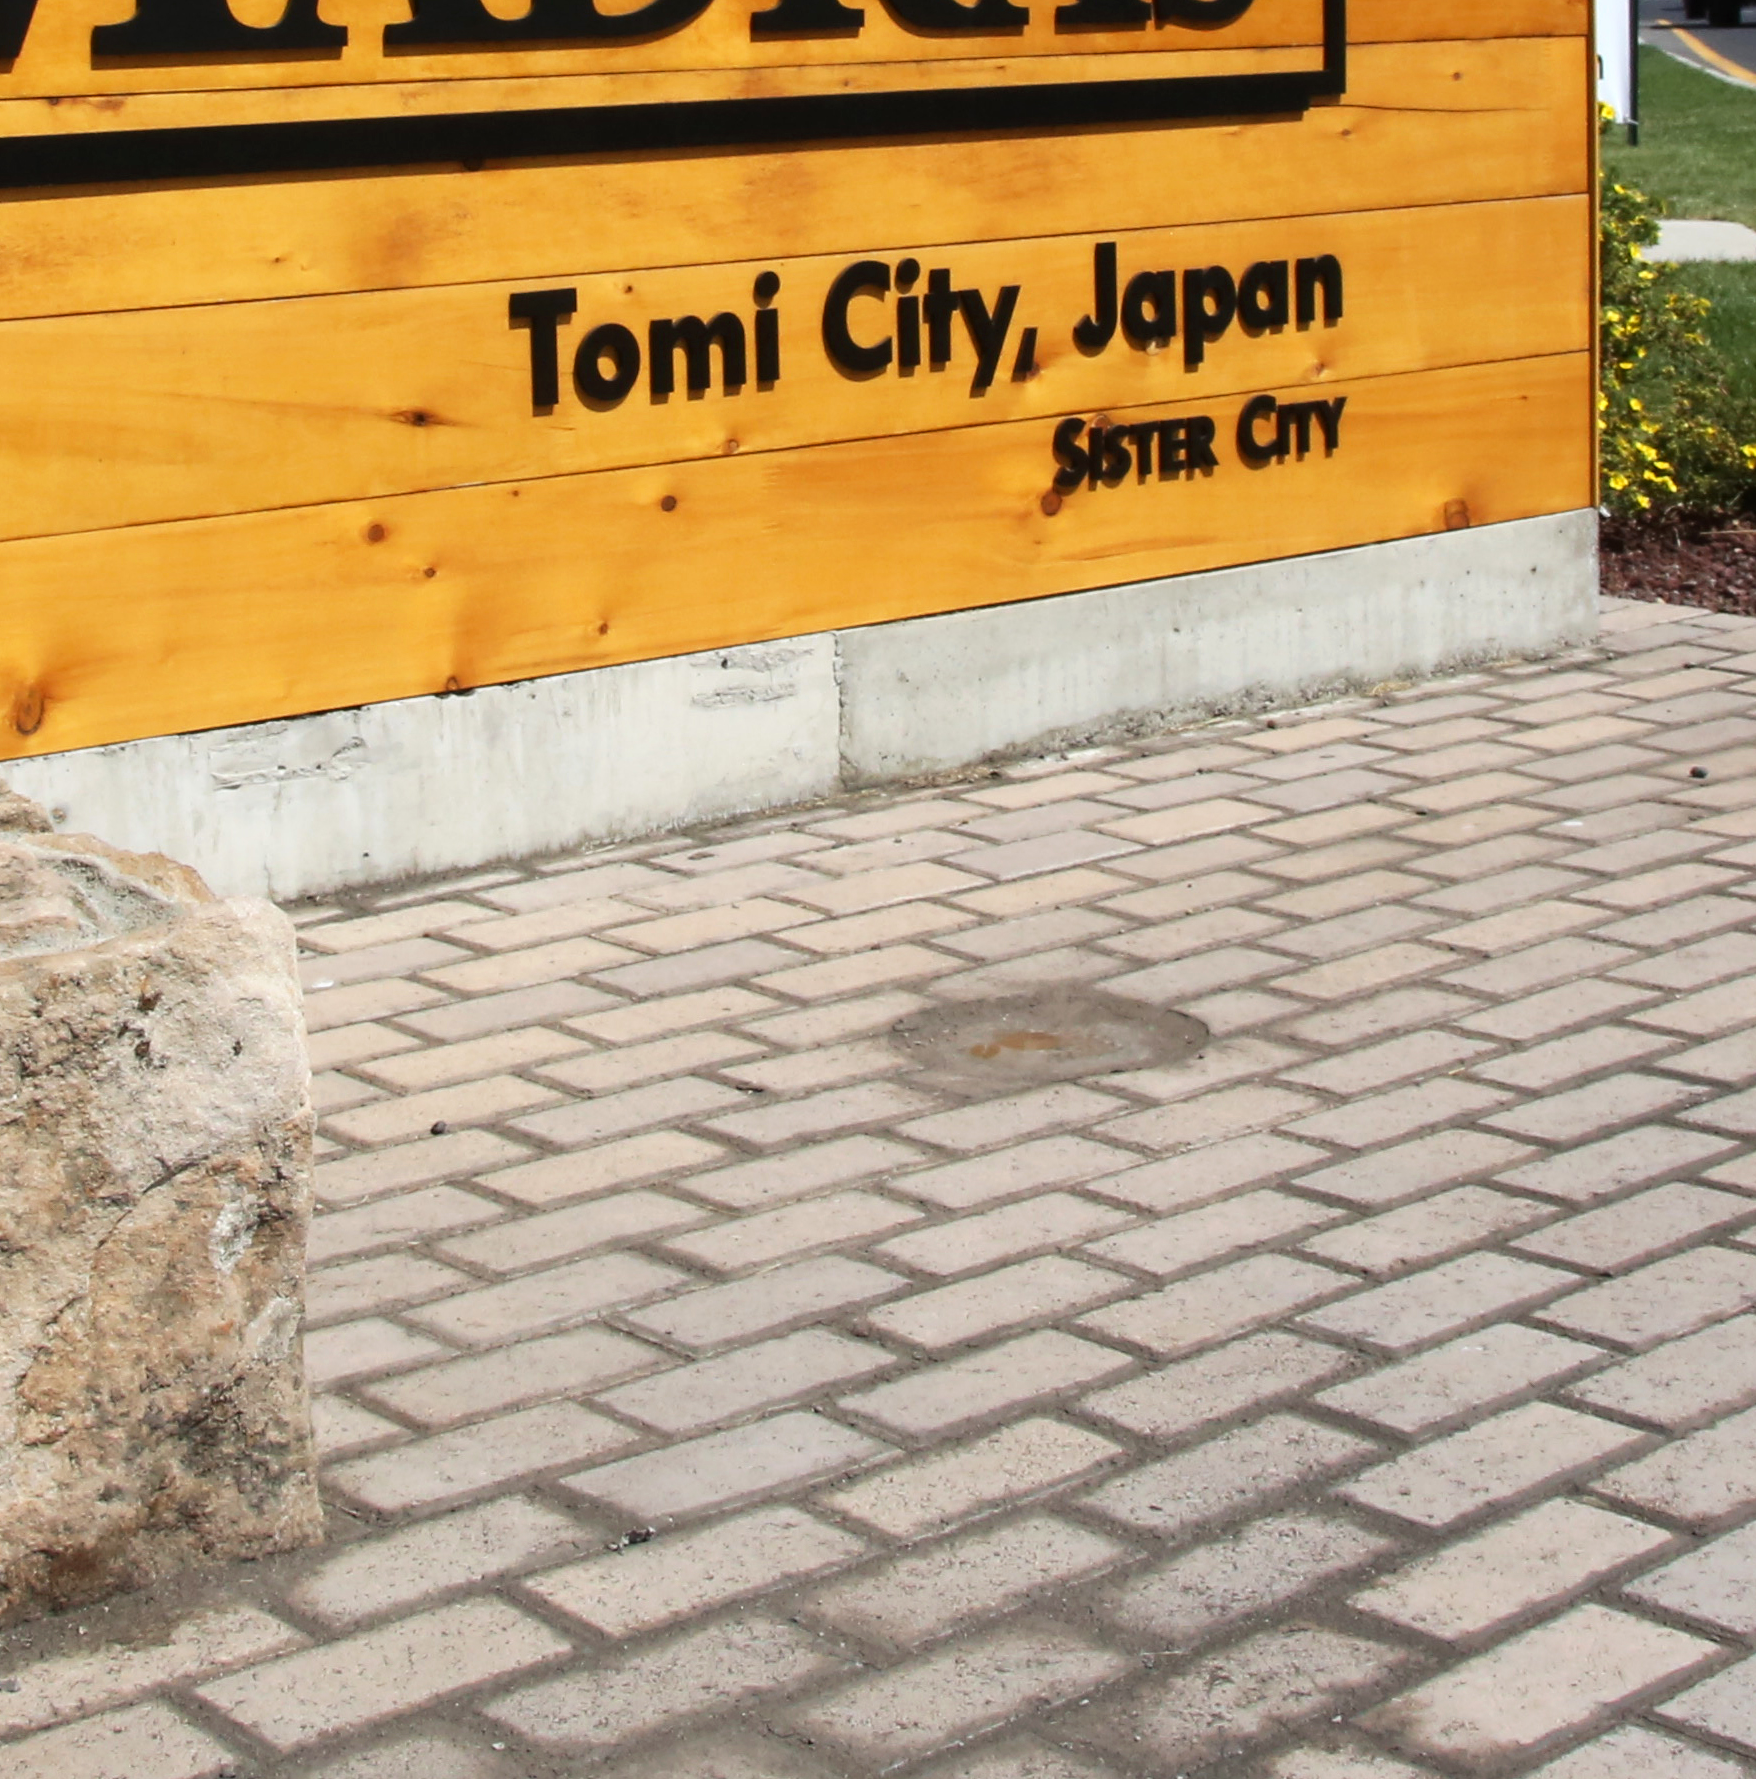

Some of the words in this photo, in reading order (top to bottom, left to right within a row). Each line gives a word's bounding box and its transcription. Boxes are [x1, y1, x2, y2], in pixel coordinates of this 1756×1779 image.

[509, 272, 780, 408] Tomi
[822, 257, 1038, 392] City,
[1073, 242, 1344, 368] Japan
[1053, 417, 1219, 495] SISTER
[1237, 395, 1347, 465] CITY
